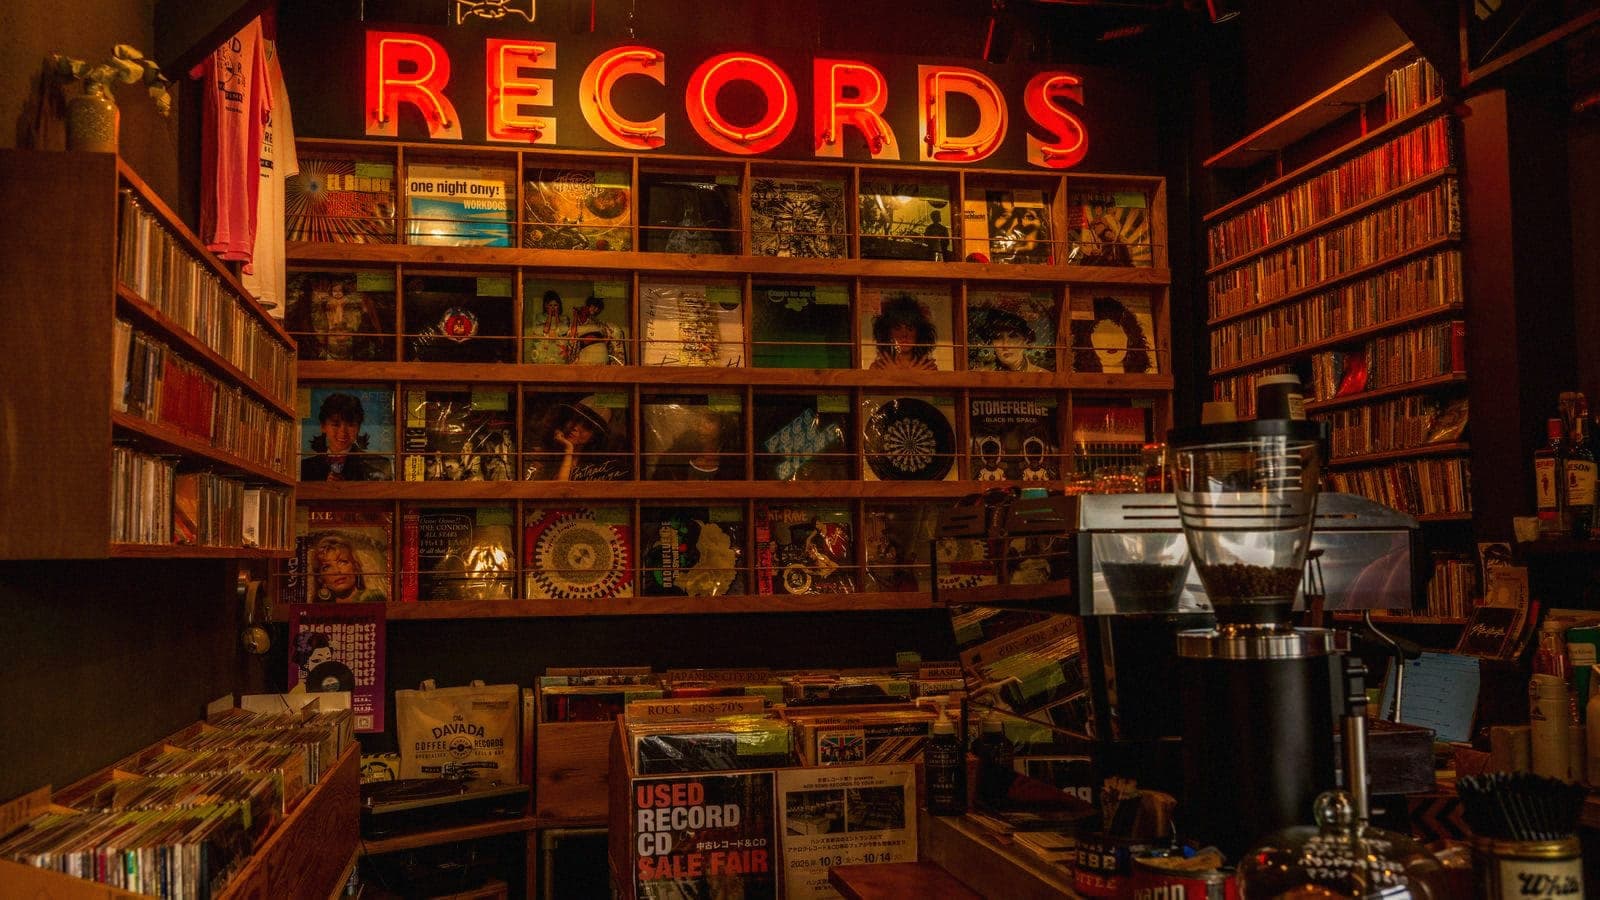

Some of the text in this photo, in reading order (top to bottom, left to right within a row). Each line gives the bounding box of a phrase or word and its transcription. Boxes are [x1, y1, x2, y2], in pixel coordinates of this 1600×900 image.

[365, 30, 1089, 169] RECORDS
[410, 181, 433, 192] one
[437, 180, 467, 197] night
[463, 200, 506, 210] WORKDOGS
[972, 400, 1049, 416] STONEFRENGE
[671, 671, 721, 681] JAPANESE
[648, 705, 681, 715] ROCK
[432, 723, 485, 739] DAVADA
[415, 738, 504, 751] COFFEE RECORDS
[637, 782, 705, 809] USED
[637, 804, 740, 833] RECORD
[637, 832, 673, 857] CD
[696, 838, 767, 850] 中古レコード&CD
[638, 849, 769, 881] SALE FAIR
[819, 855, 843, 867] 10/3
[863, 852, 891, 863] 10/14
